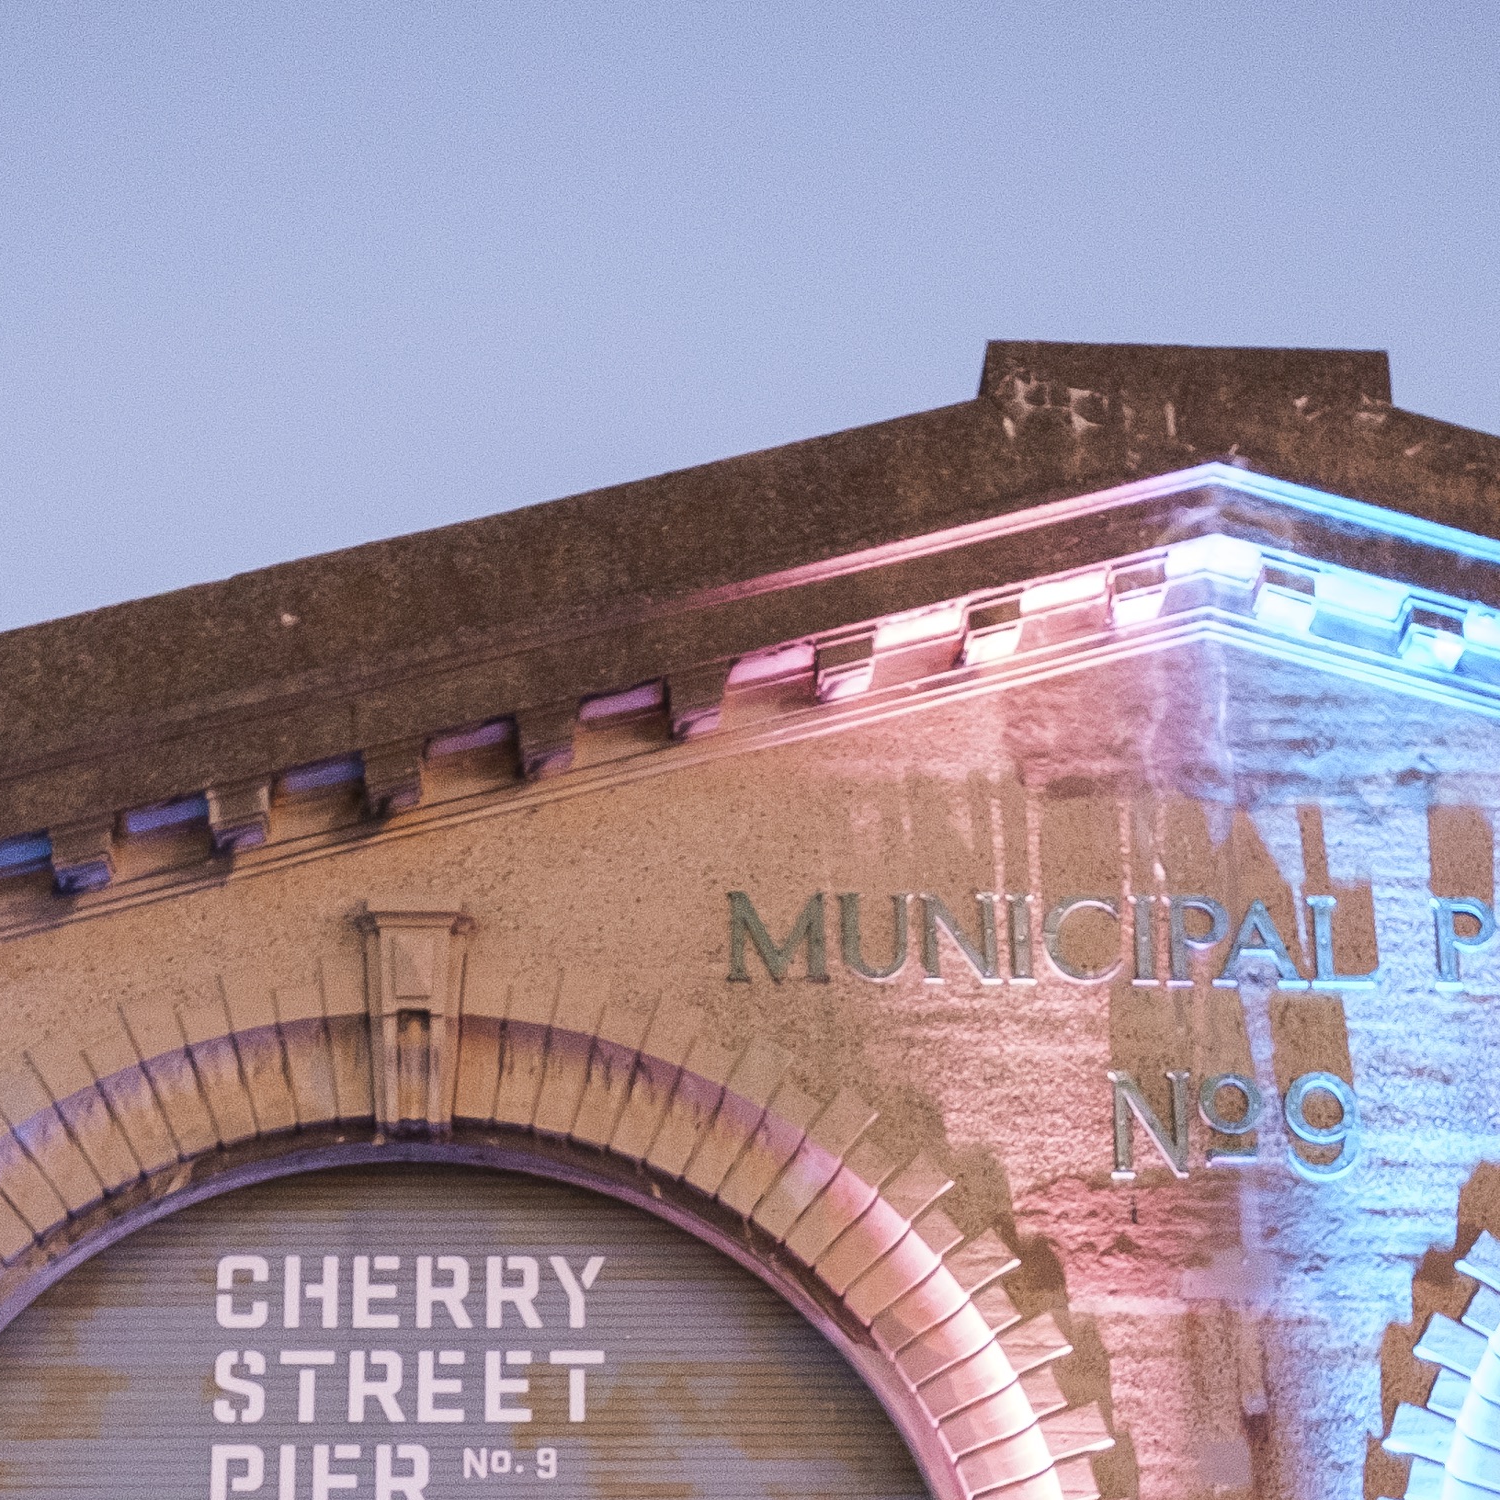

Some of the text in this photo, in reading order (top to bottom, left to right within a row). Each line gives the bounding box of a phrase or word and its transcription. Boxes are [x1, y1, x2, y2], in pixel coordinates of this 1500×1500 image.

[726, 890, 1379, 990] MUNICIPAL
[1285, 1071, 1360, 1182] 9
[216, 1255, 605, 1328] CHERRY
[213, 1351, 605, 1422] STREET
[463, 1447, 523, 1479] No.
[536, 1447, 558, 1479] 9
